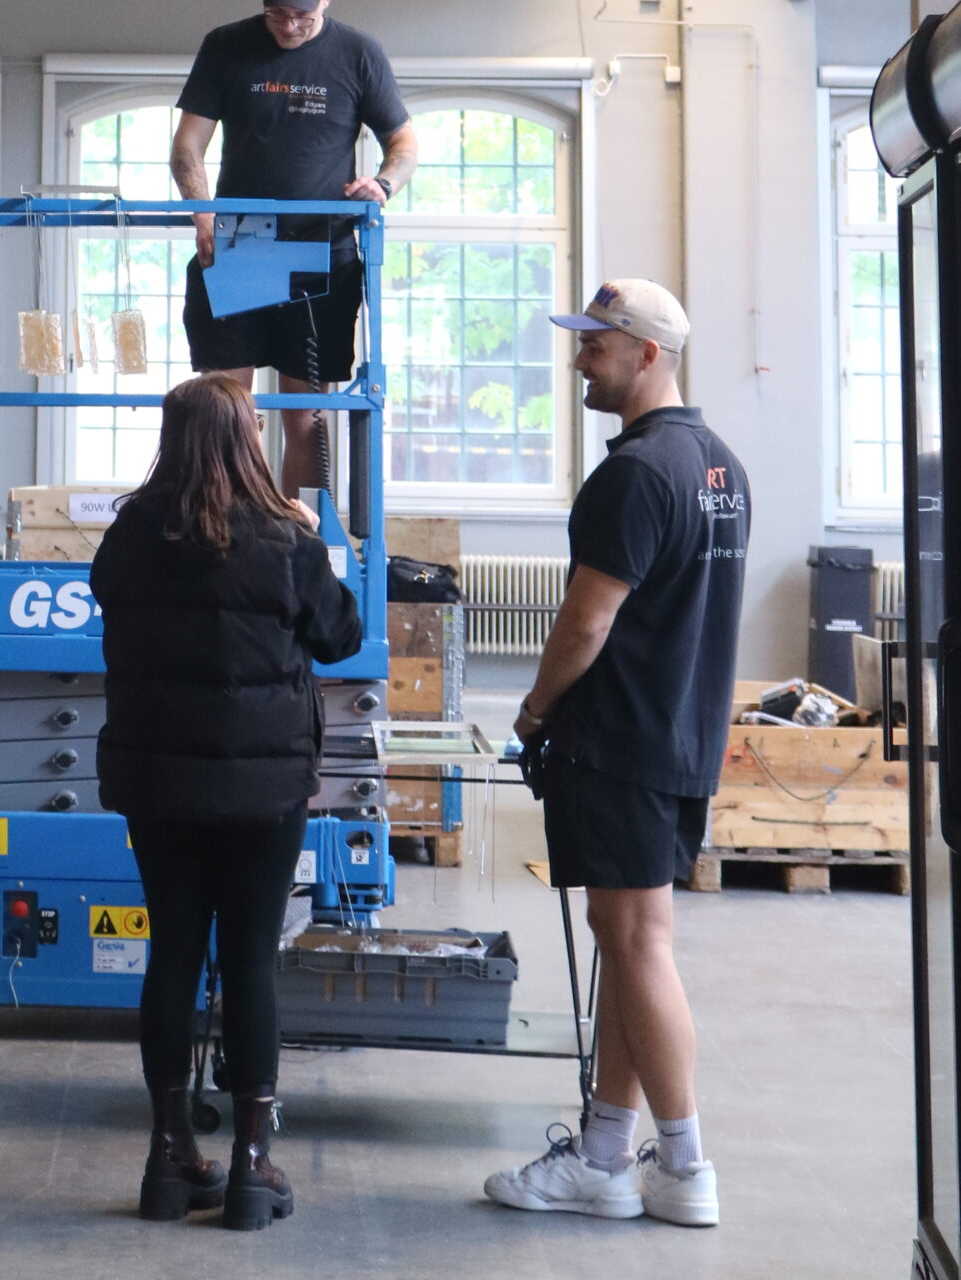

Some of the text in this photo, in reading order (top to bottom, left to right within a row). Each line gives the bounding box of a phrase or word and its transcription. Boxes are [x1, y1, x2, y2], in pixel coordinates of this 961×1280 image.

[706, 467, 727, 489] RT
[80, 502, 105, 513] 90W
[713, 546, 733, 559] the
